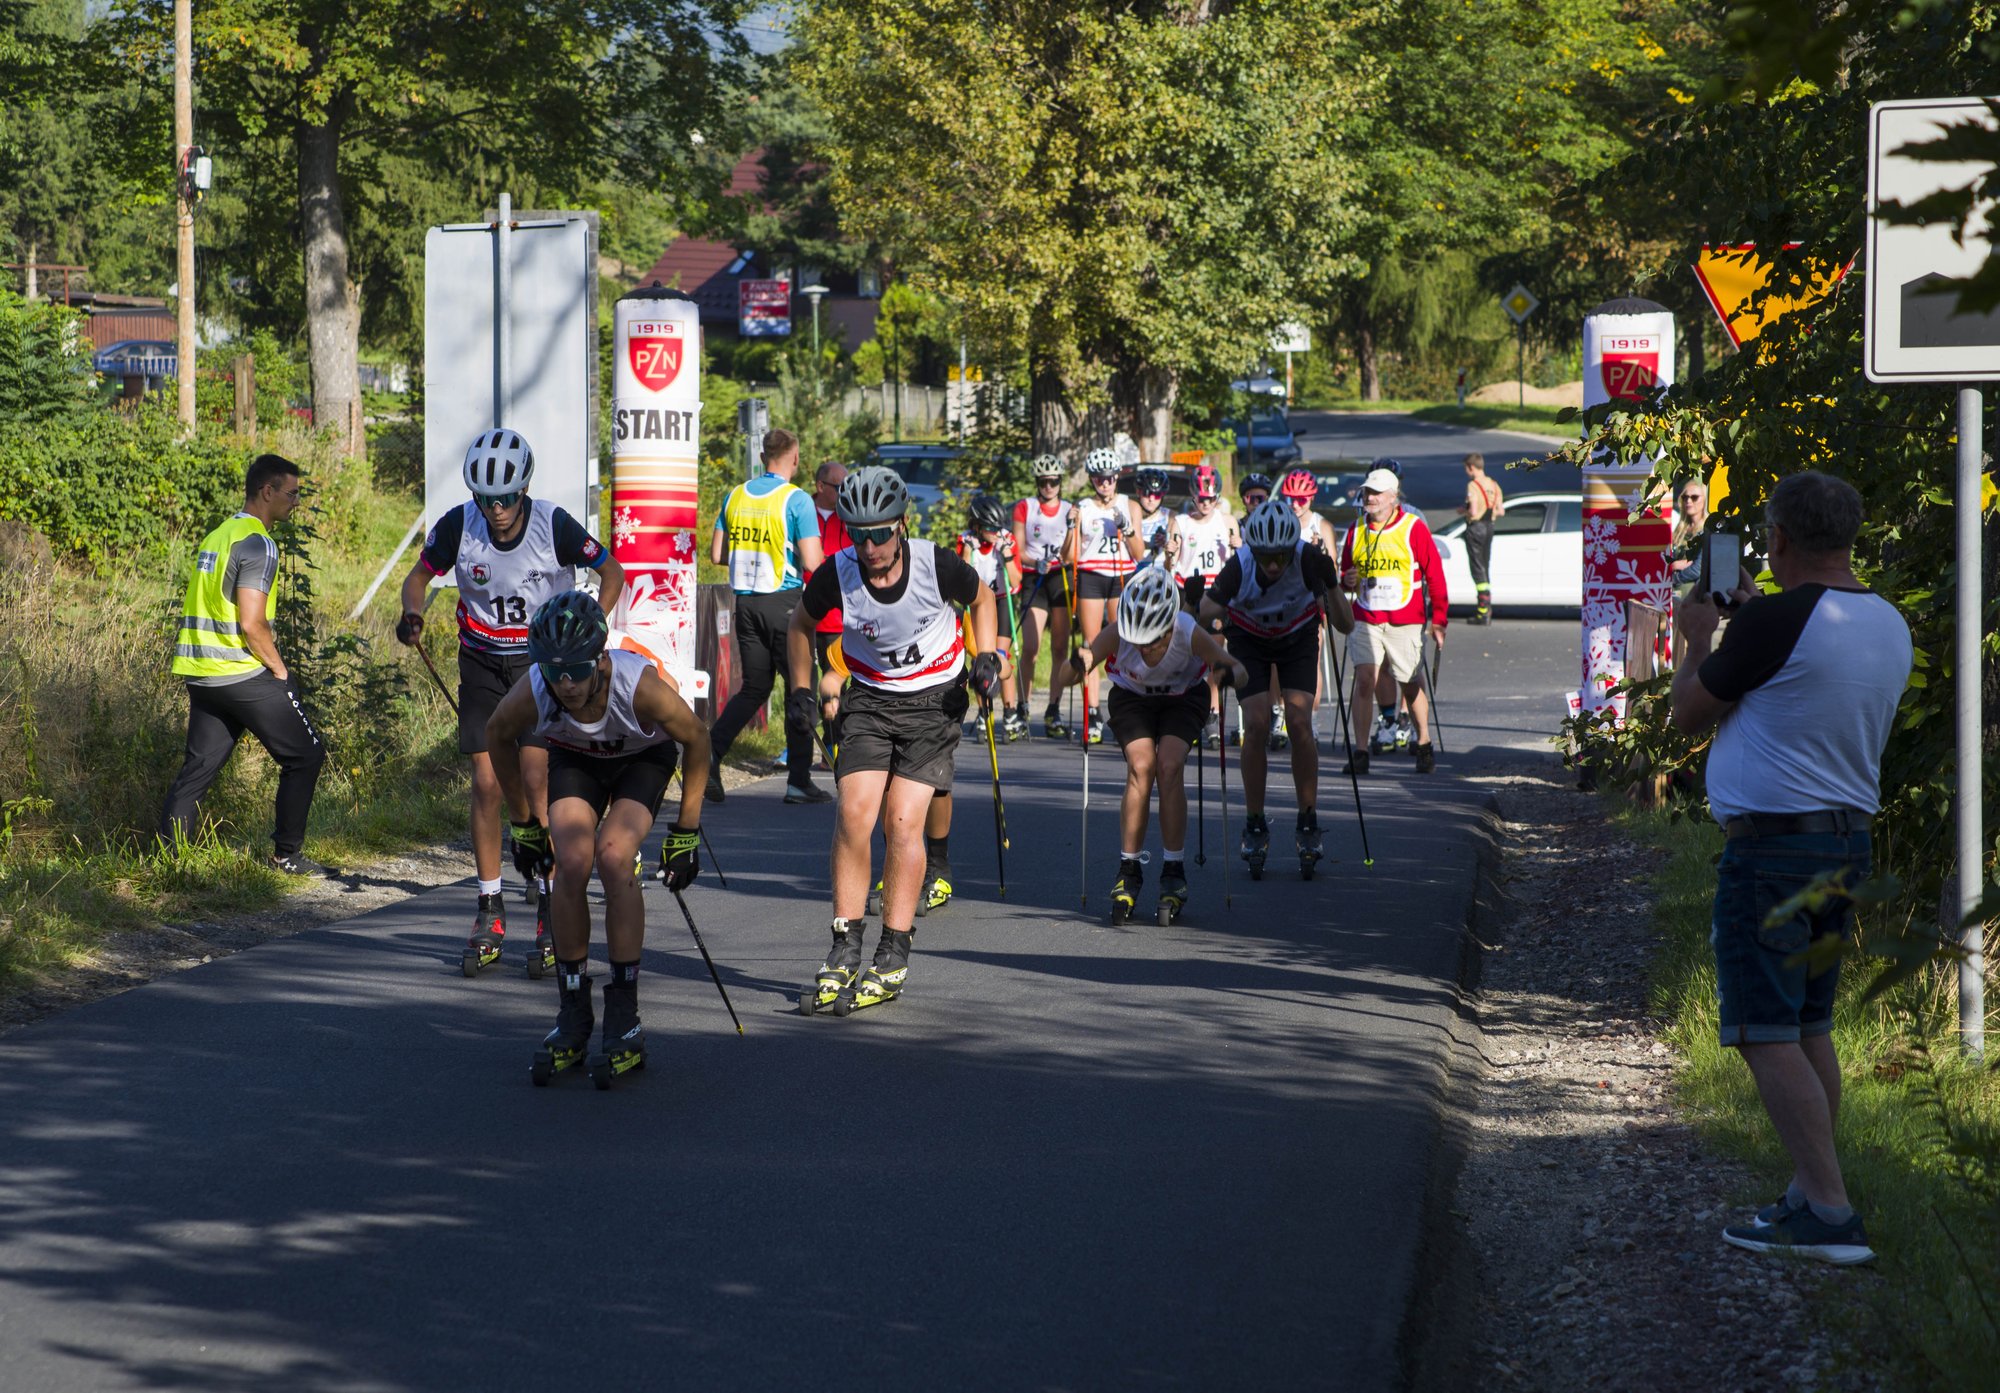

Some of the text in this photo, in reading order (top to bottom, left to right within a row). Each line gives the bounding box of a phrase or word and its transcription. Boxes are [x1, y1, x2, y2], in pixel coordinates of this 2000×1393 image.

[637, 324, 674, 333] 1919
[1611, 339, 1650, 349] 1919
[636, 343, 676, 378] PZN
[1609, 359, 1652, 395] PZN
[616, 409, 693, 441] START
[1098, 535, 1119, 554] 25
[1199, 550, 1215, 570] 18
[490, 595, 527, 624] 13
[880, 642, 924, 669] 14
[287, 691, 320, 745] POLSKA
